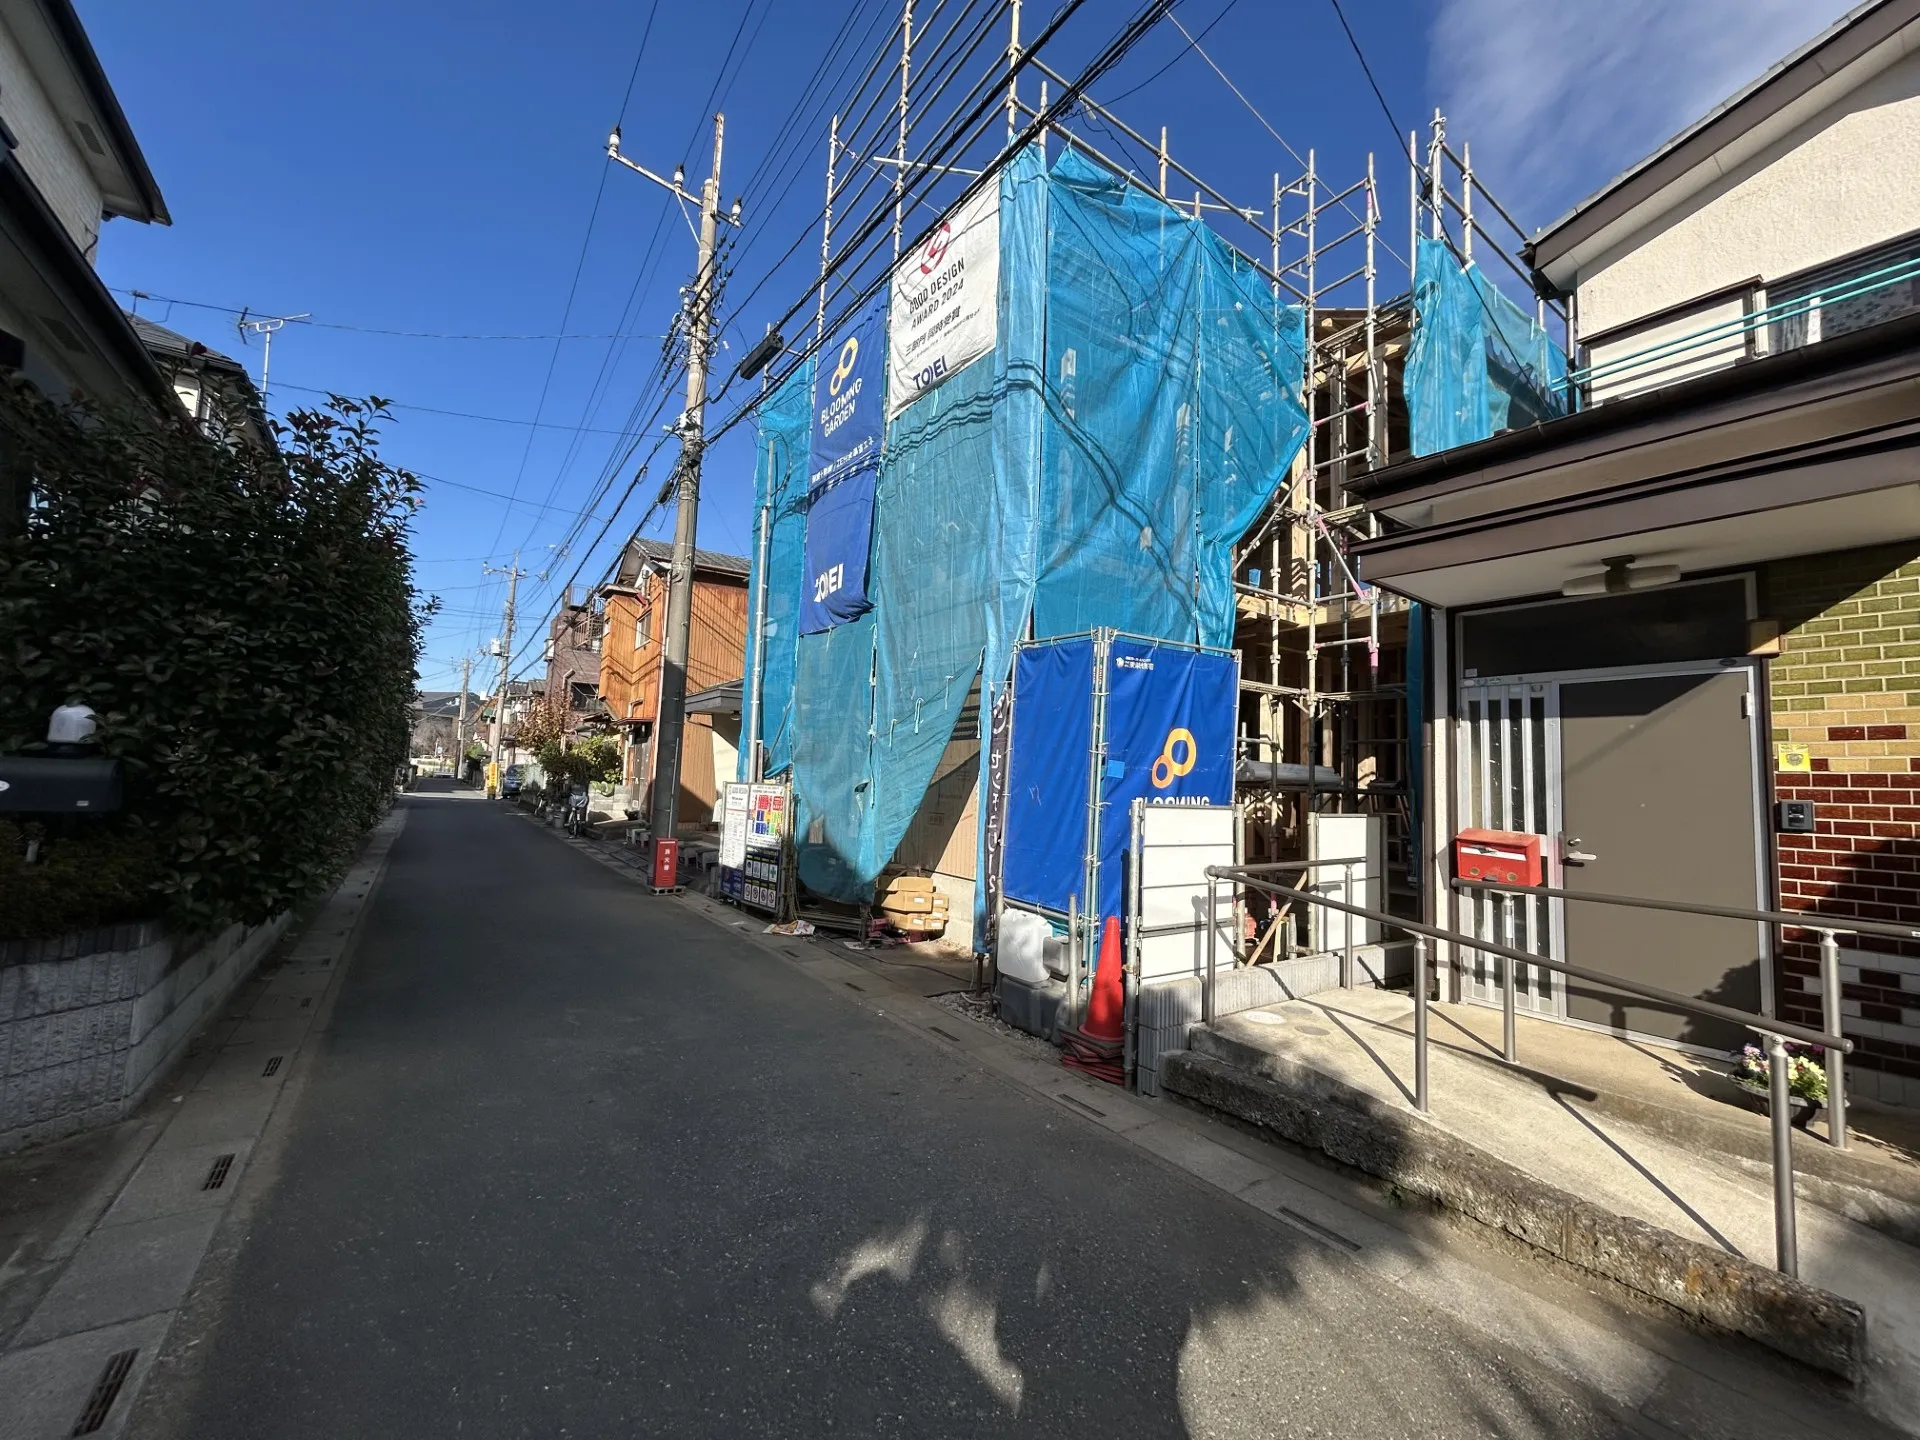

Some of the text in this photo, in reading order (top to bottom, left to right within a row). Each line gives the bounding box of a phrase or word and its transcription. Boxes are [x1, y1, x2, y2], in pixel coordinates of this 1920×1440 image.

[909, 256, 965, 315] GOOD DESIGN
[911, 277, 964, 331] AWARD 2024
[912, 354, 948, 391] TOEI
[820, 377, 863, 425] BLOOMING
[824, 399, 856, 438] GARDEN
